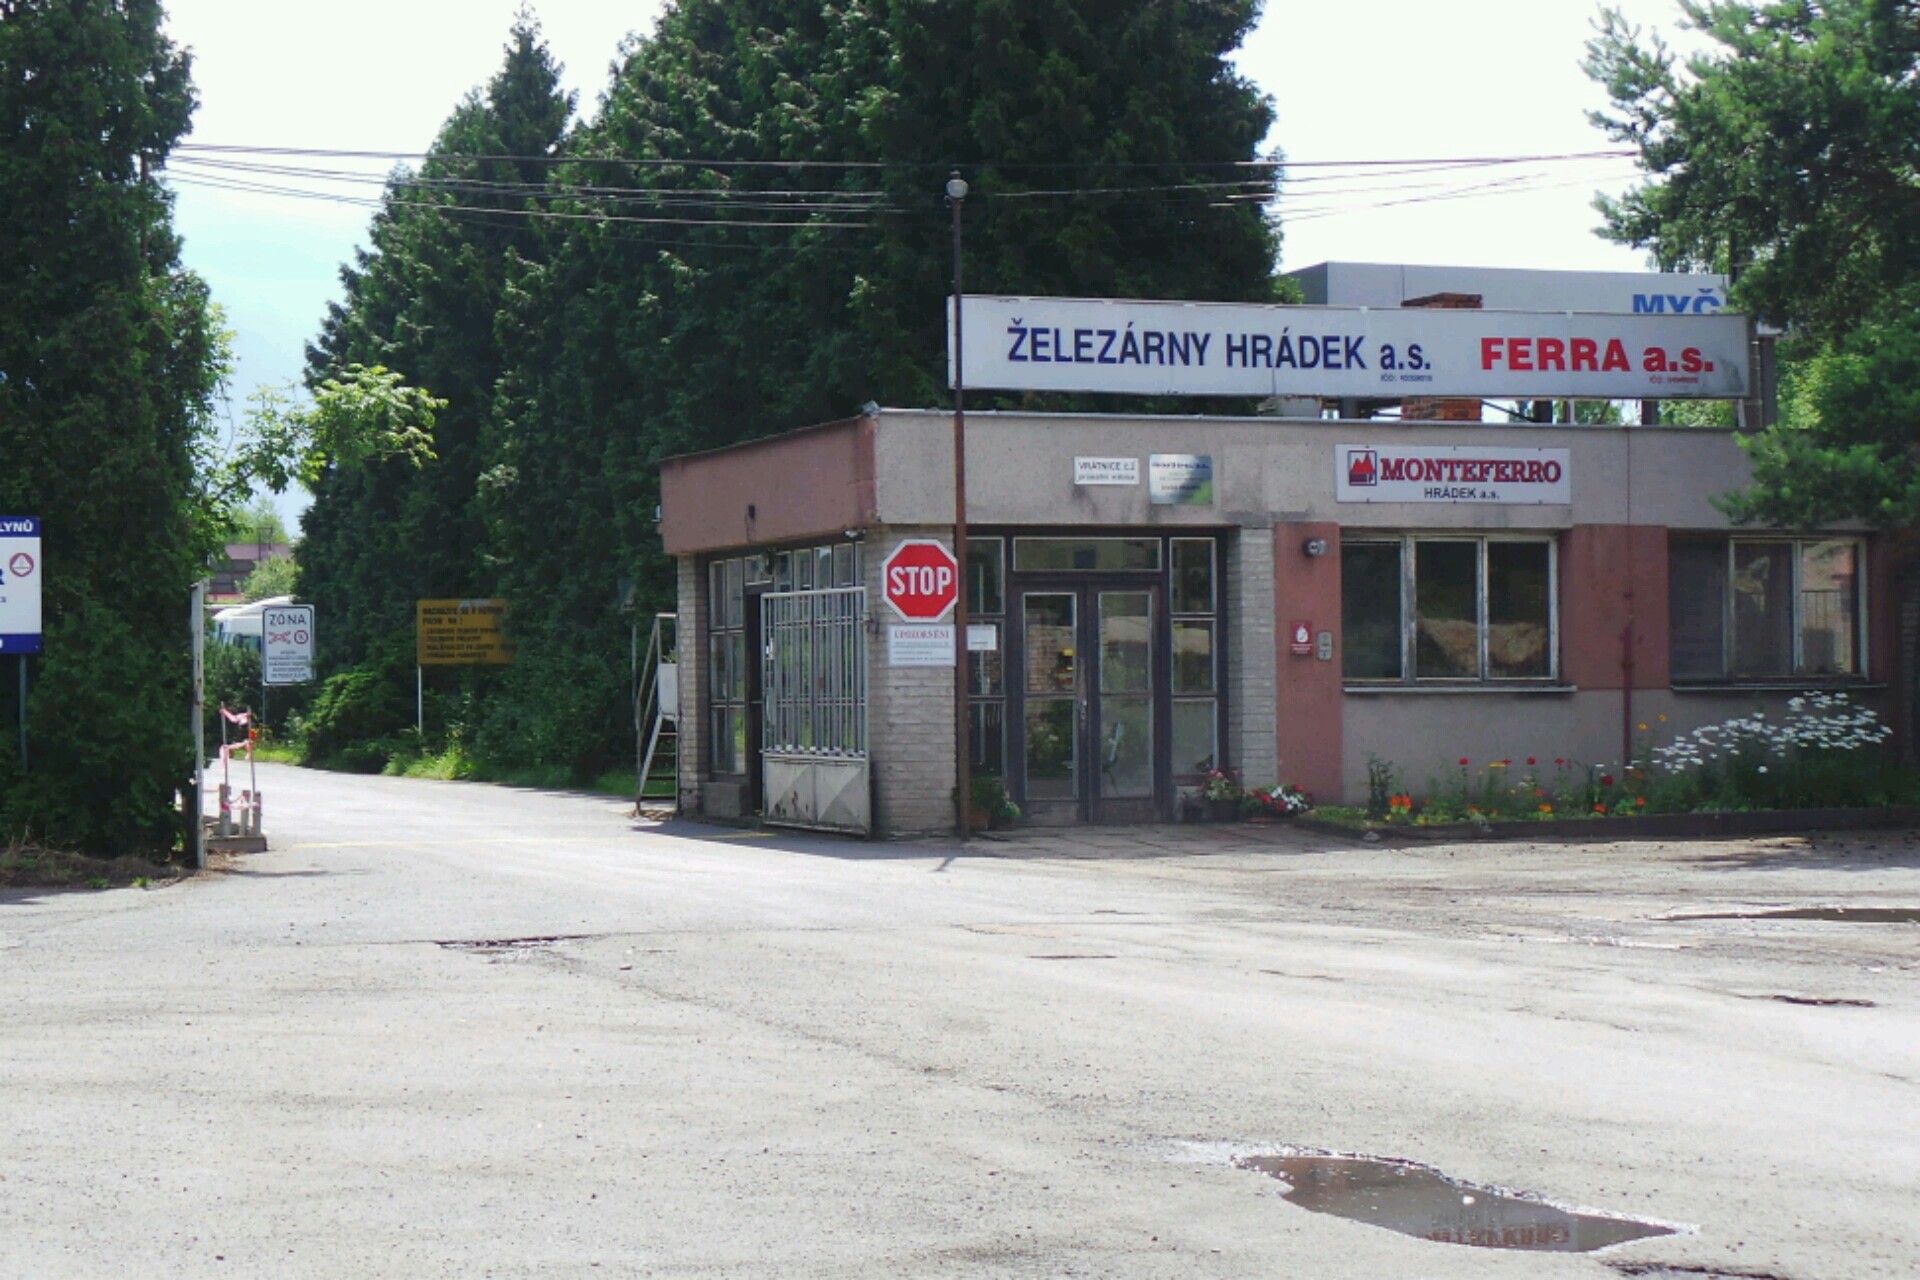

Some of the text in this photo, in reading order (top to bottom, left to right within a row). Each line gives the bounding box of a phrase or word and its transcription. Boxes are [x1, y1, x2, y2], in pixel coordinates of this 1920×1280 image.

[1007, 318, 1431, 371] ŽELEZÁRNY HRÁDEK a.s.
[1481, 337, 1714, 373] FERRA a.s.
[1380, 458, 1561, 483] MONTEFERRO
[1424, 485, 1500, 500] HRÁDEK a.s.
[890, 566, 952, 596] STOP
